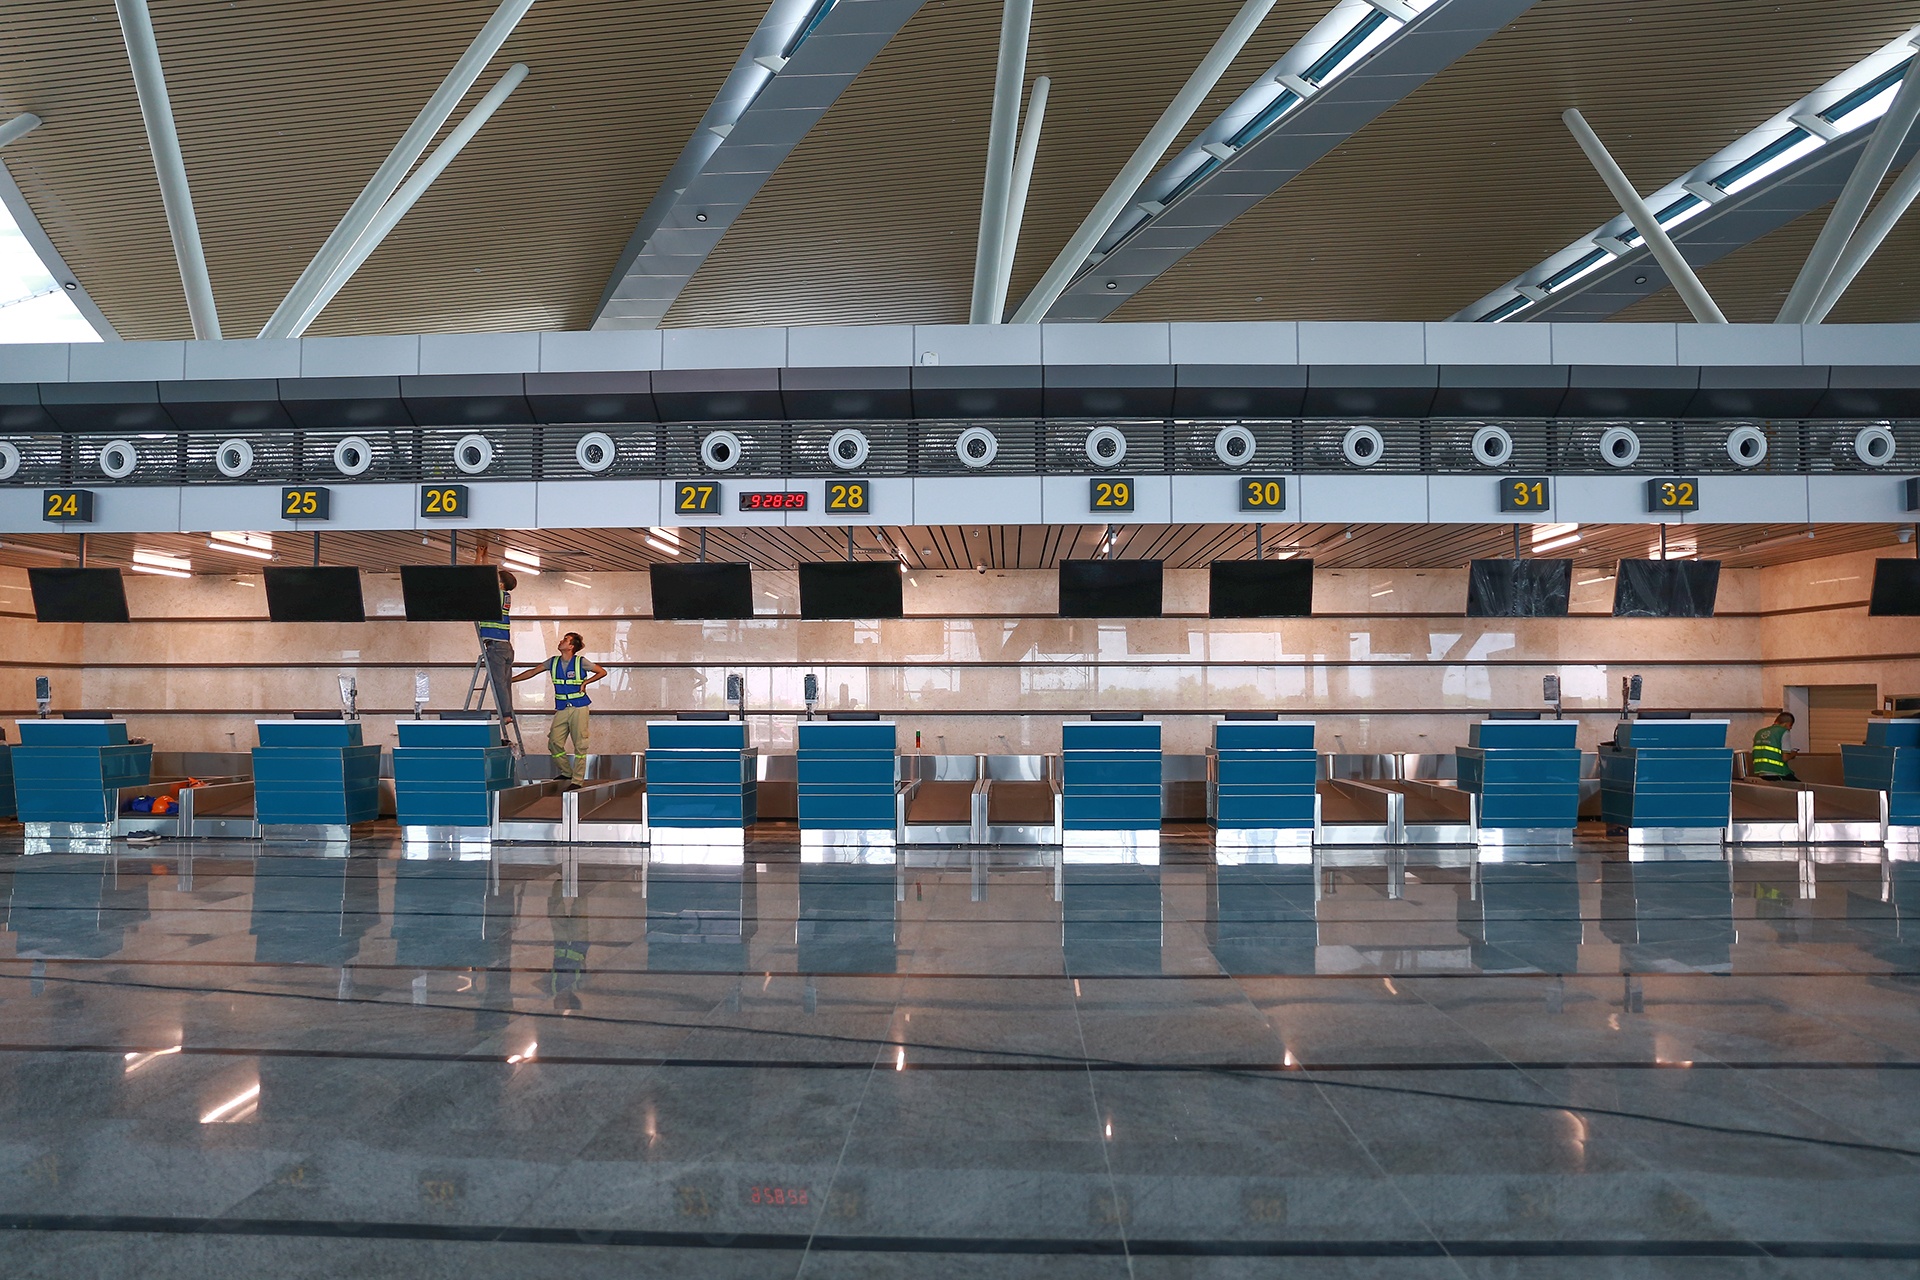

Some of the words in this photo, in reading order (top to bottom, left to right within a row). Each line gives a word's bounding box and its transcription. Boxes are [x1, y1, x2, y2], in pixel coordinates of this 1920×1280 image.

[46, 493, 78, 517] 24
[286, 491, 317, 514] 25
[426, 489, 458, 513] 26
[680, 486, 713, 510] 27
[830, 484, 864, 509] 28
[1096, 482, 1130, 507] 29
[1247, 481, 1281, 506] 30
[1513, 482, 1543, 506] 31
[1661, 482, 1694, 506] 32
